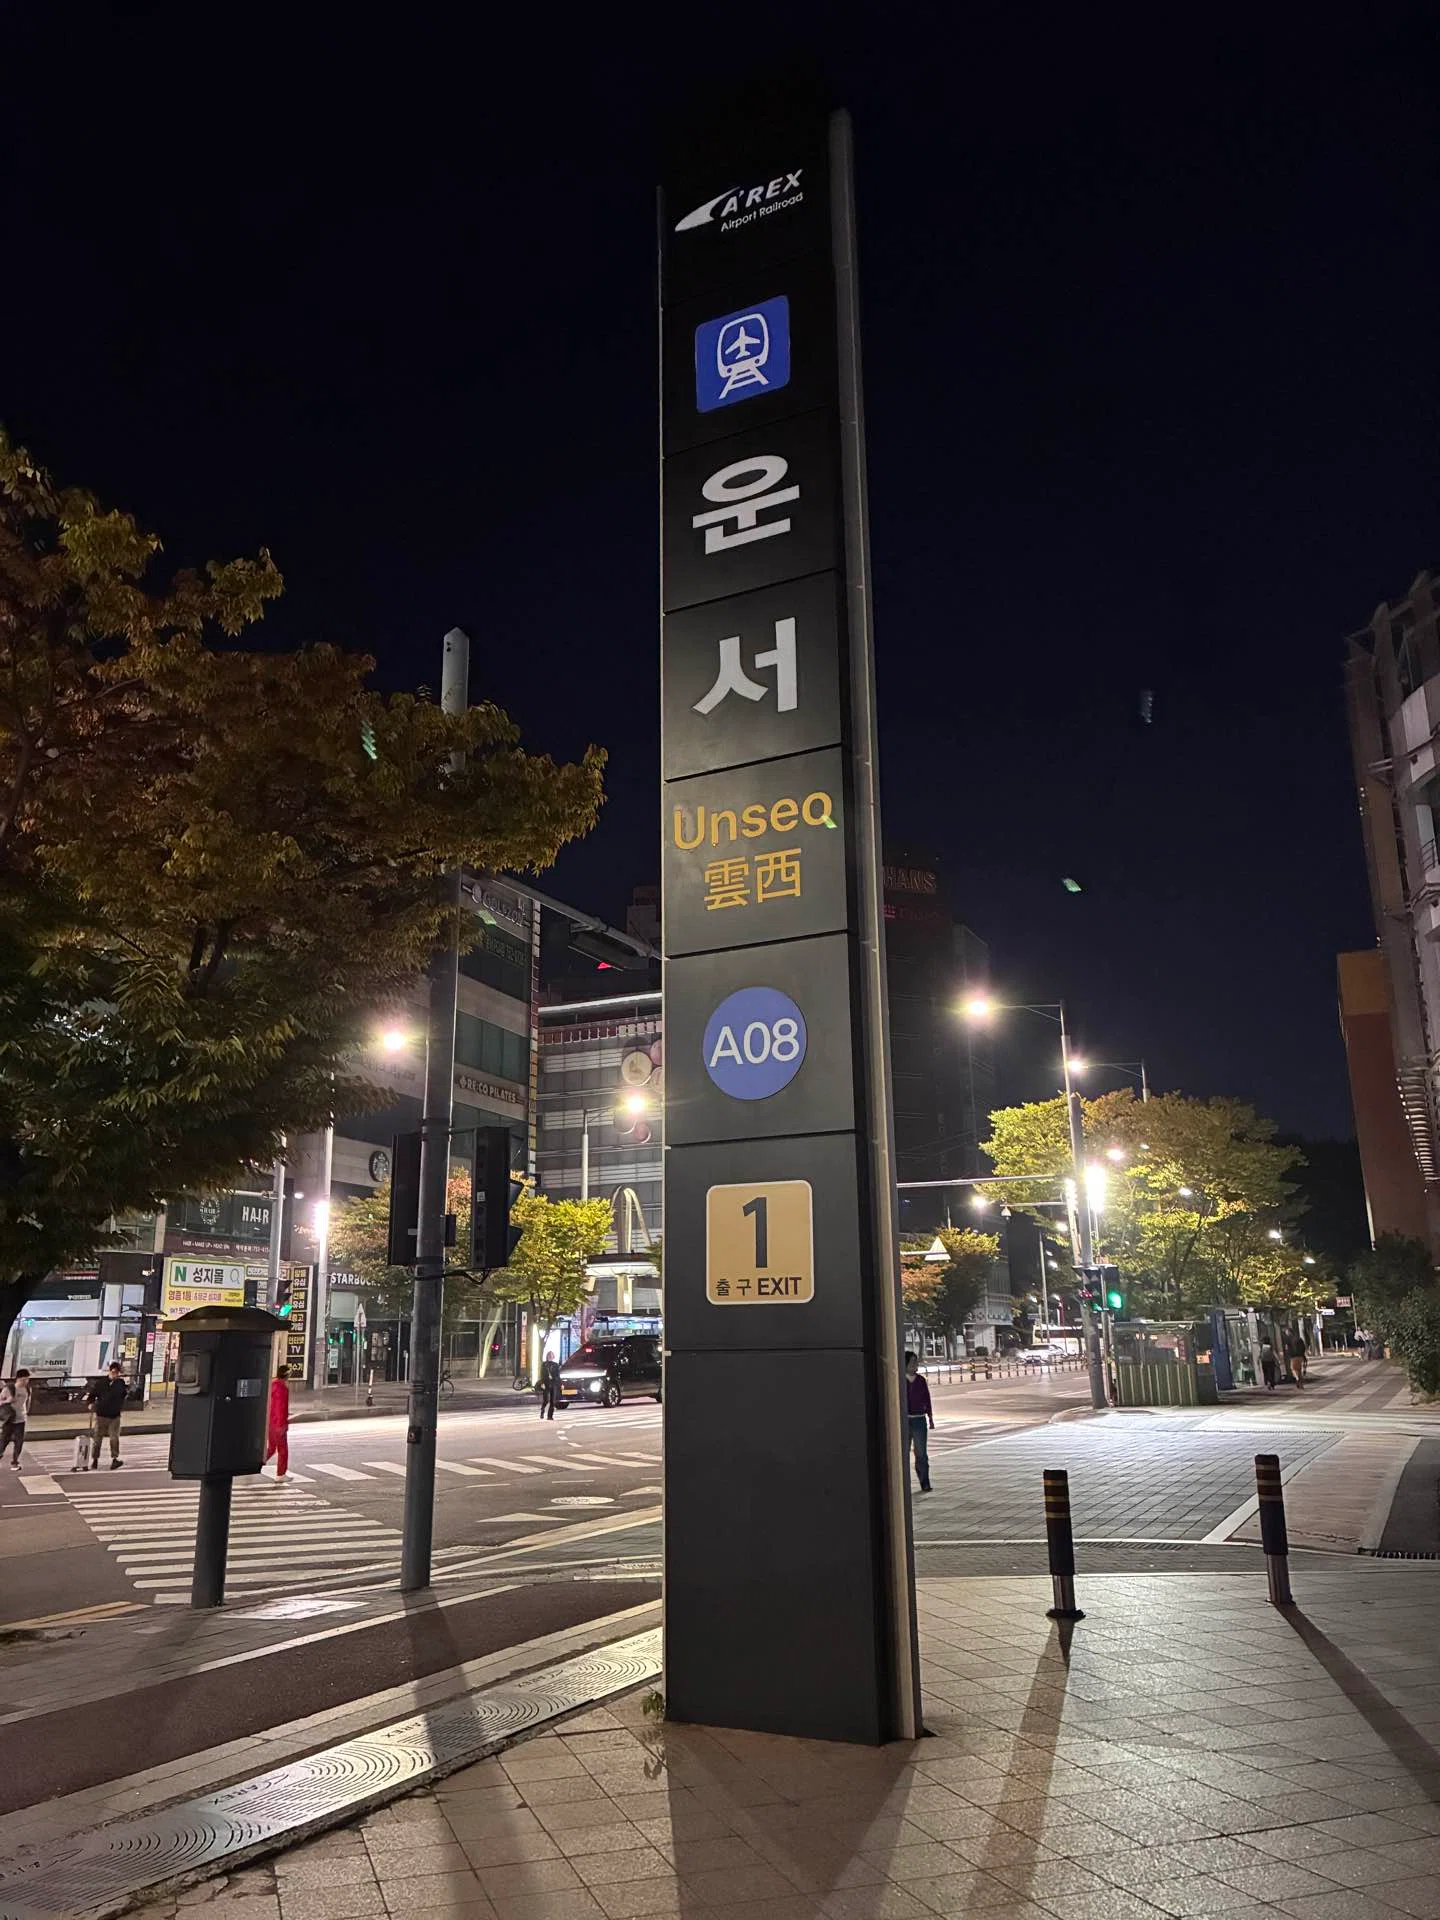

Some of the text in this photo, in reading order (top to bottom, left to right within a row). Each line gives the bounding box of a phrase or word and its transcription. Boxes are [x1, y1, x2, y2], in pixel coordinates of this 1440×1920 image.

[721, 192, 804, 232] Airport Railroad
[674, 791, 833, 850] Unseo
[704, 848, 801, 910] 雲西
[709, 1017, 800, 1067] A08
[489, 1085, 516, 1104] PILATES
[242, 1206, 269, 1224] HAIR
[742, 1196, 768, 1268] 1
[174, 1266, 187, 1282] N
[193, 1267, 224, 1284] 성지몰
[331, 1272, 381, 1286] STARBUC
[758, 1277, 802, 1296] EXIT
[291, 1345, 301, 1354] TV
